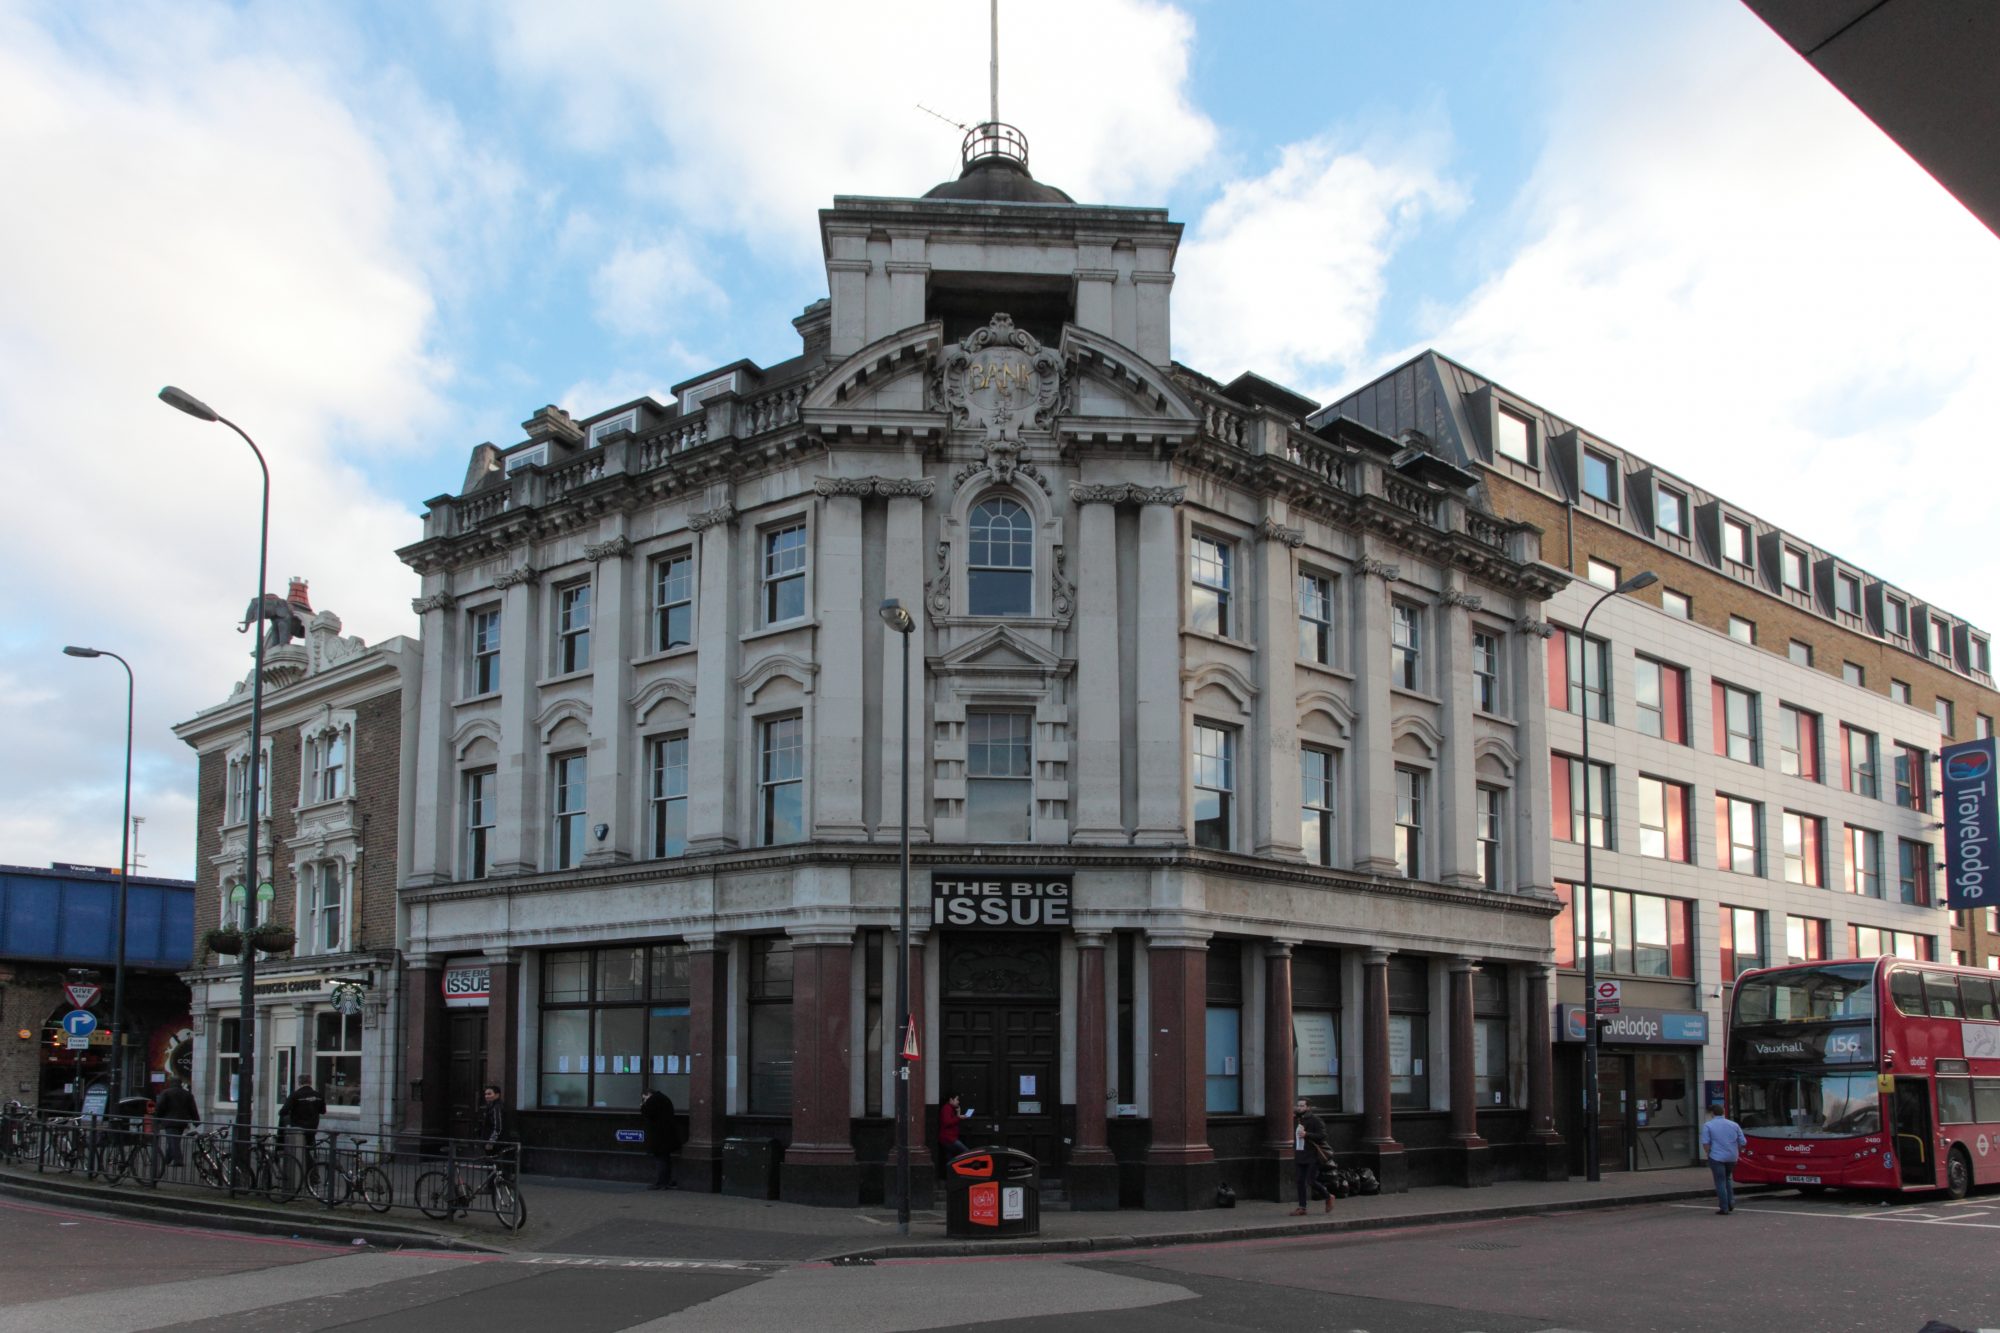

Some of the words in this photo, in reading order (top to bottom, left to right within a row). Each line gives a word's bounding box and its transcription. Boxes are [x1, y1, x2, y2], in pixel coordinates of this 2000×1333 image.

[968, 362, 1035, 395] BANK
[1956, 781, 1989, 899] Travelodge
[69, 864, 96, 872] Vauxhall
[935, 881, 1003, 896] THE
[1011, 882, 1069, 896] BIG
[934, 897, 1070, 925] ISSUE
[447, 970, 471, 978] THE
[72, 987, 94, 995] GIVE
[287, 979, 322, 993] COFFEE
[447, 977, 490, 993] ISSUE
[1755, 1041, 1804, 1054] Vauxhall
[1831, 1036, 1858, 1053] 156
[1784, 1144, 1812, 1153] abellio
[621, 1260, 704, 1268] LOOK
